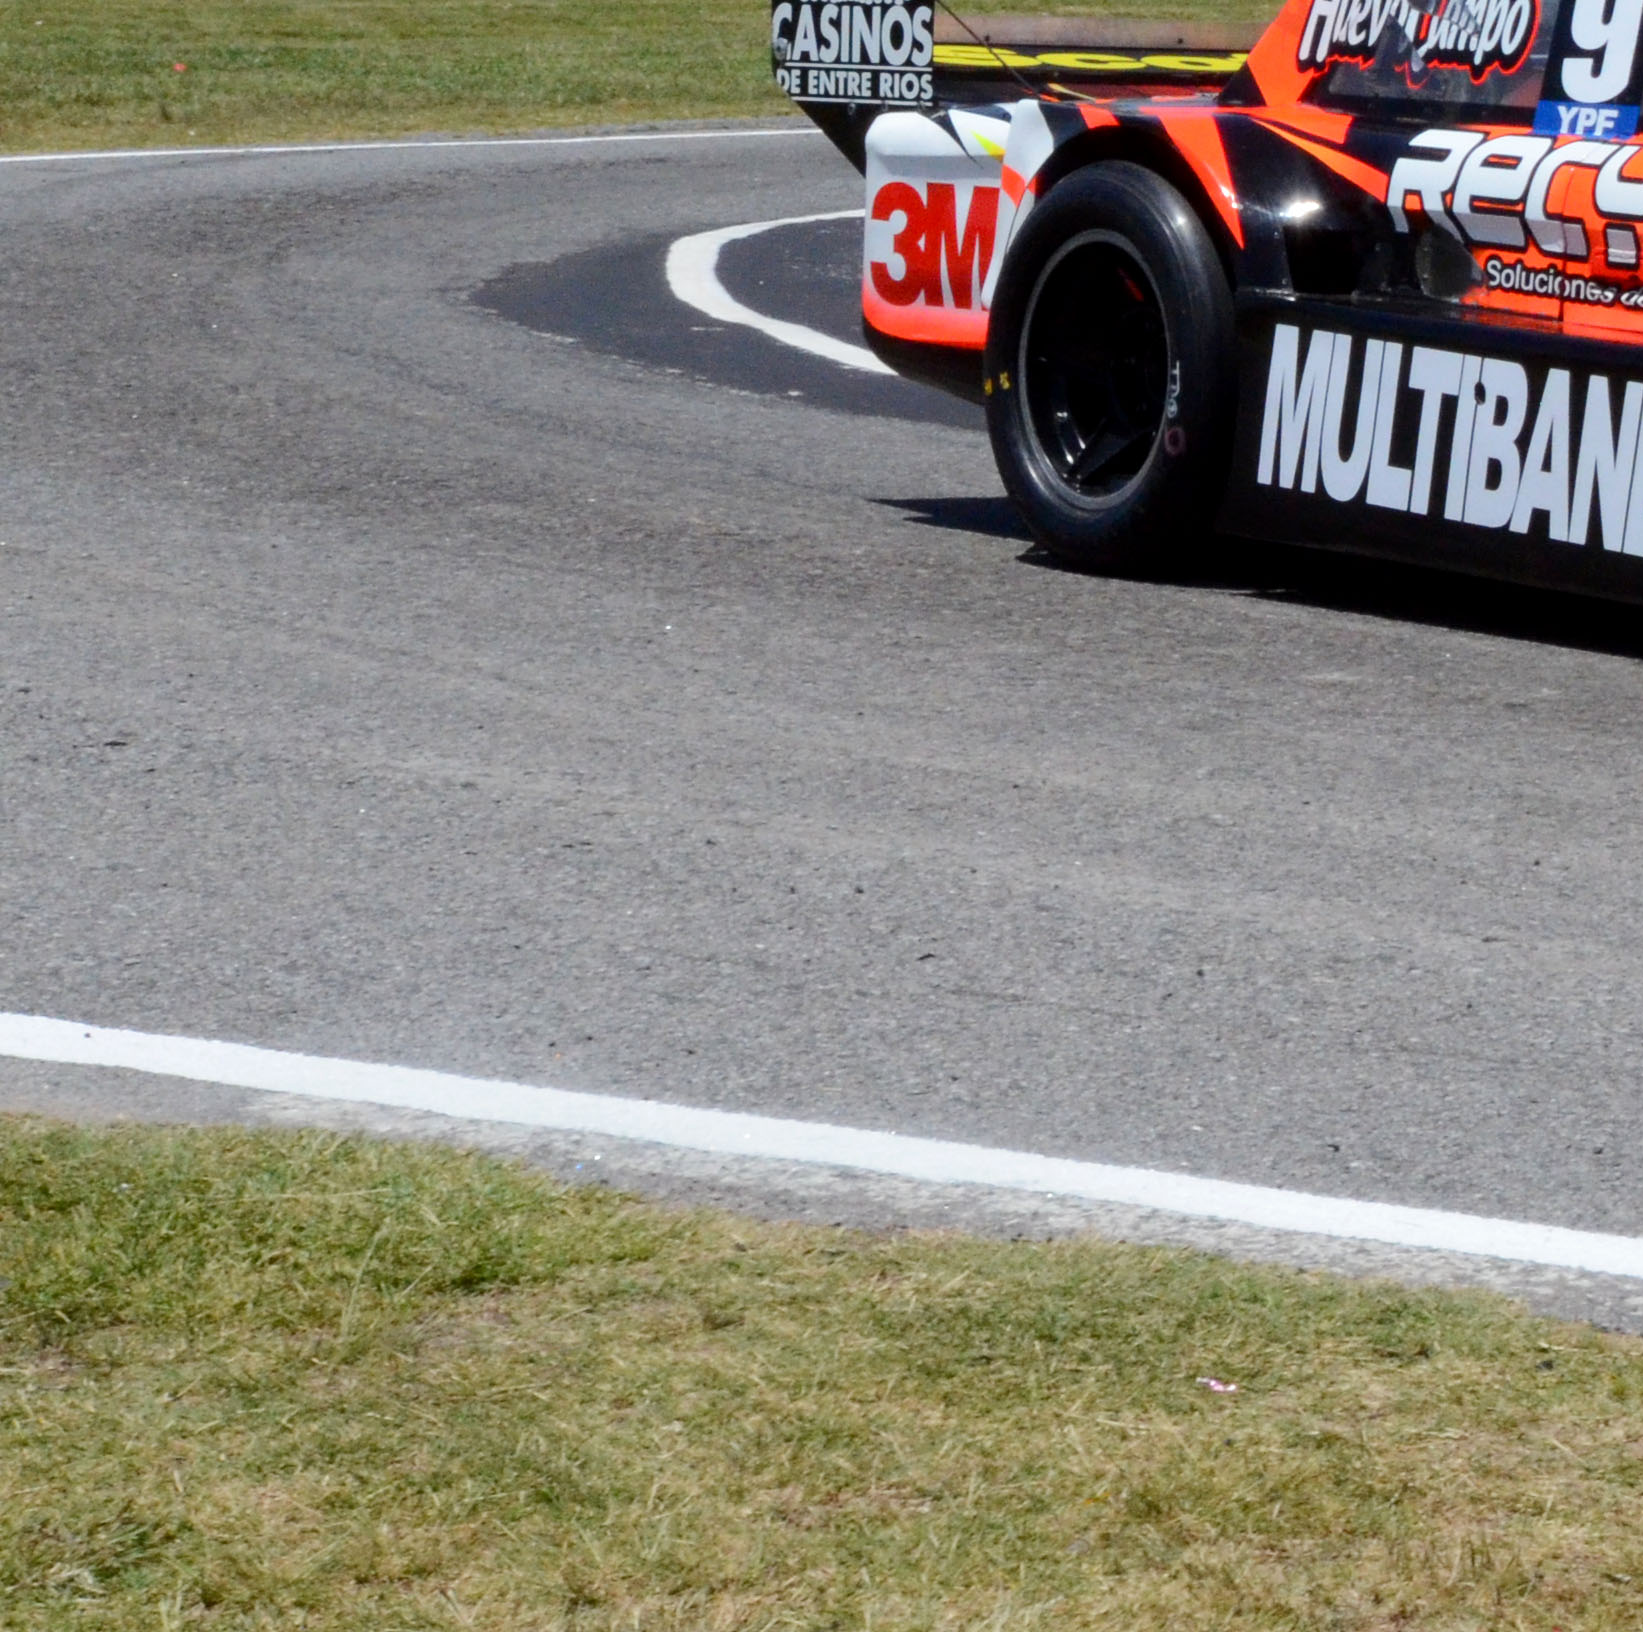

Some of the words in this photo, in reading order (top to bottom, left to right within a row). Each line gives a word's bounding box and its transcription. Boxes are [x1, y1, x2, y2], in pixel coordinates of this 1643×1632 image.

[772, 2, 933, 66] CASINOS
[776, 69, 800, 94] DE
[808, 70, 872, 96] ENTRE
[879, 72, 934, 100] RIOS
[1557, 106, 1620, 136] YPF
[870, 181, 1000, 311] 3M
[1486, 259, 1614, 304] Soluciones
